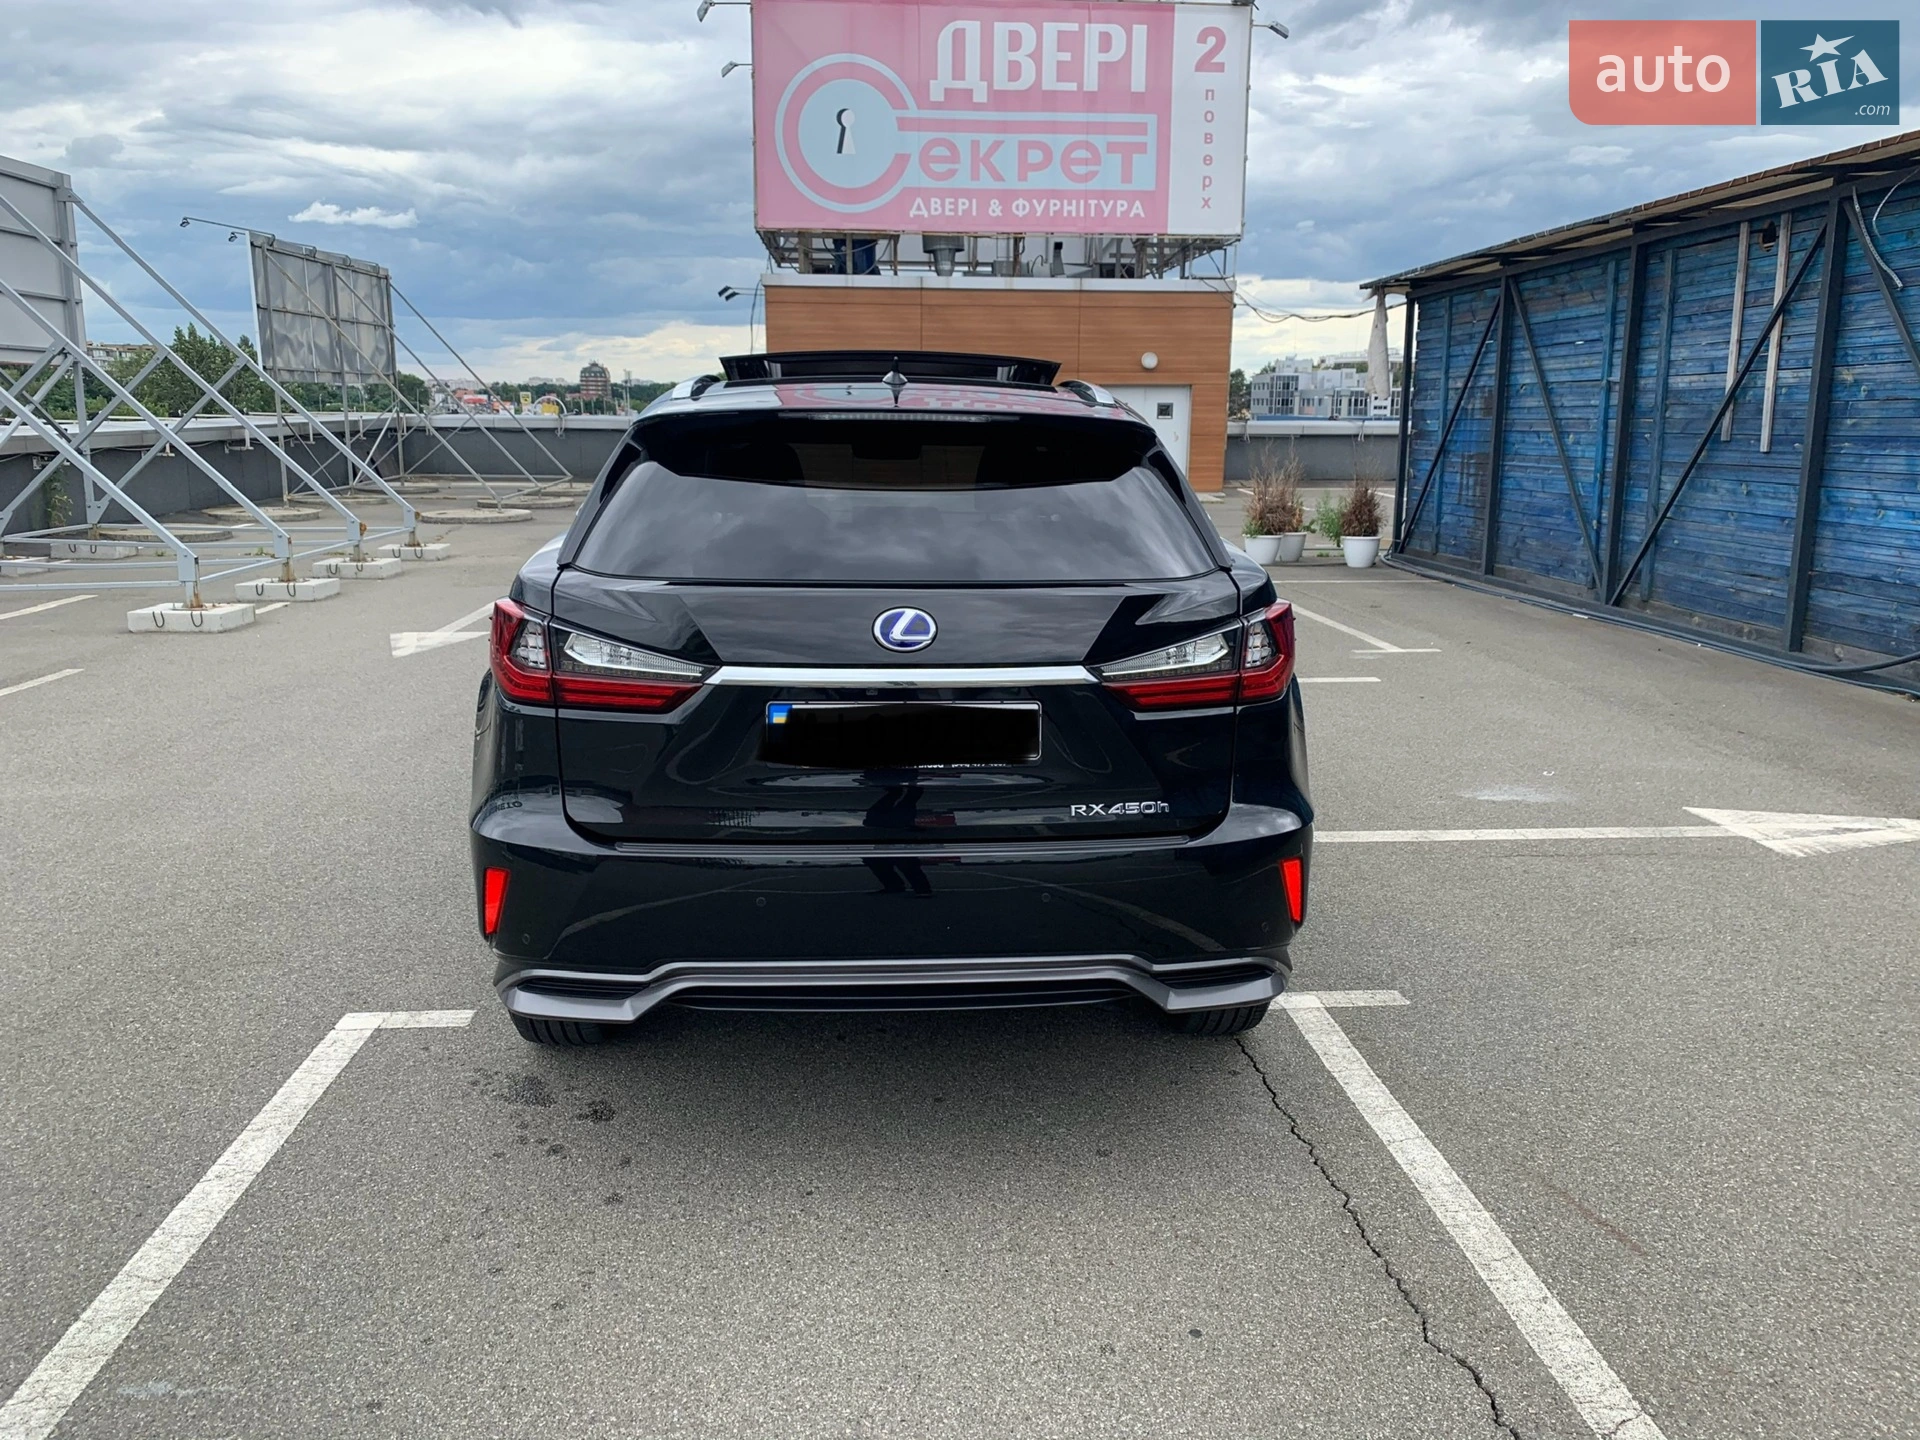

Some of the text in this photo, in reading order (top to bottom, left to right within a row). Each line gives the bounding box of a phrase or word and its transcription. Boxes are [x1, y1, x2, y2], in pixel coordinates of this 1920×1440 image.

[929, 20, 1148, 103] ДВЕРІ
[1194, 26, 1227, 73] 2
[1201, 88, 1216, 210] поверх
[909, 197, 1146, 218] ДВЕРІ & ФУРНІТУРА
